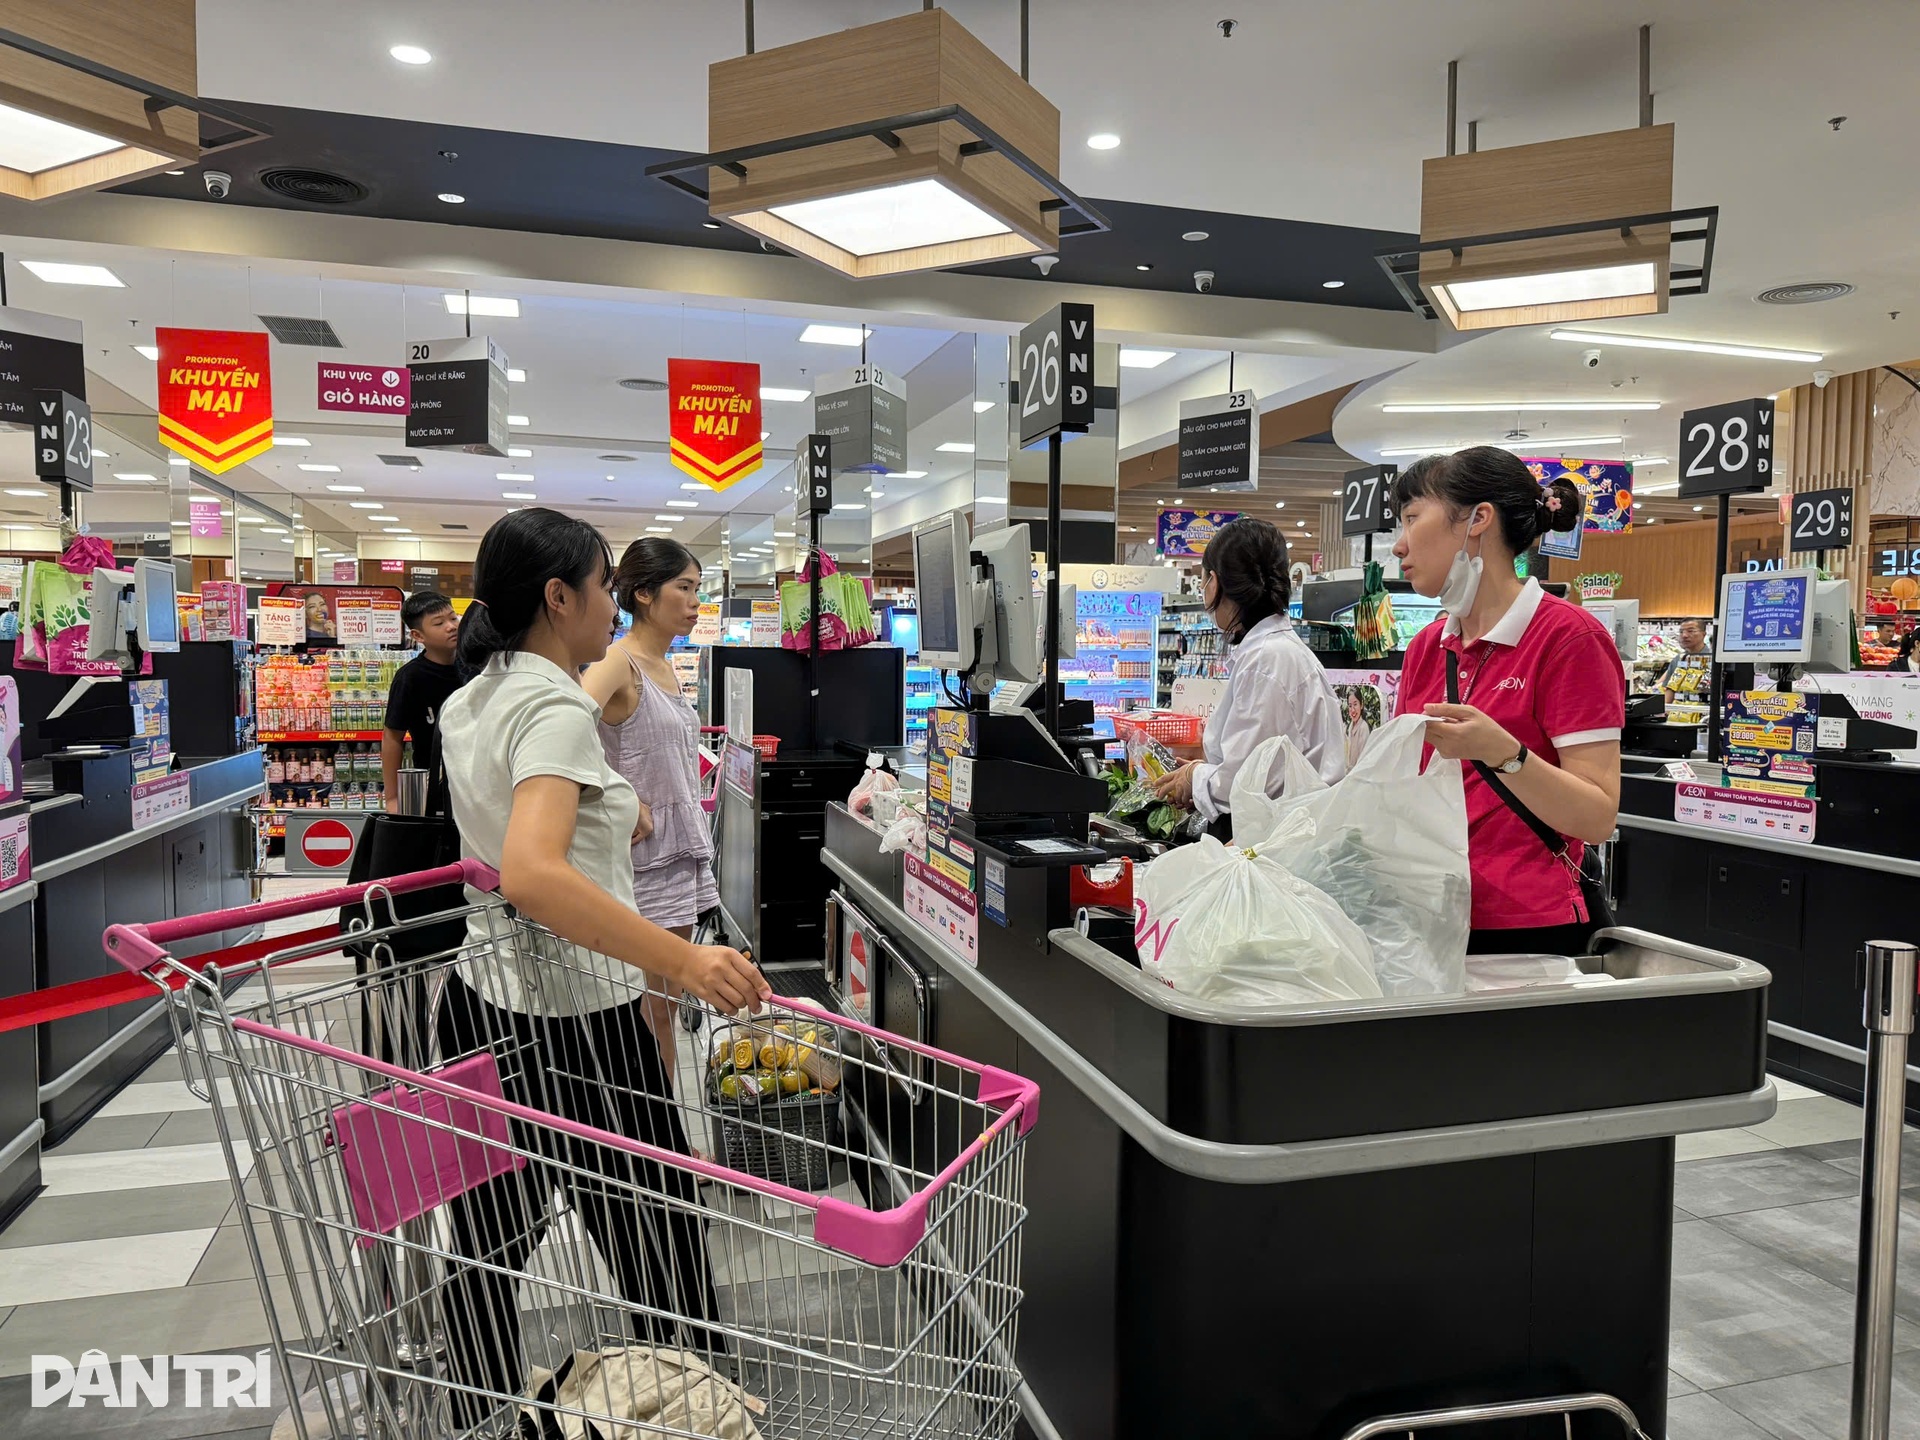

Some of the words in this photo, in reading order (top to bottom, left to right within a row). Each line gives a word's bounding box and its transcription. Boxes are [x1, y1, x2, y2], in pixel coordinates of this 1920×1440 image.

[185, 356, 238, 365] PROMOTION
[412, 345, 430, 359] 20
[1069, 320, 1088, 405] VNĐ
[169, 366, 260, 388] KHUYẾN
[323, 370, 346, 380] KHU
[349, 371, 372, 382] VỰC
[855, 368, 867, 384] 21
[874, 369, 882, 386] 22
[1023, 330, 1059, 418] 26
[323, 388, 354, 404] GIỎ
[359, 391, 405, 407] HÀNG
[691, 384, 734, 393] PROMOTION
[187, 390, 244, 418] MẠI
[678, 393, 752, 414] KHUYẾN
[1230, 394, 1245, 408] 23
[40, 401, 58, 463] VNĐ
[693, 415, 738, 440] MẠI
[65, 410, 91, 469] 23
[1686, 417, 1749, 478] 28
[1757, 410, 1770, 473] VNĐ
[796, 451, 810, 500] 25
[814, 445, 827, 498] VNĐ
[1345, 478, 1379, 522] 27
[1794, 500, 1835, 538] 29
[1840, 496, 1850, 537] VNĐ
[1583, 576, 1608, 588] Salad
[1584, 589, 1592, 597] TỰ
[1592, 588, 1612, 596] CHỌN
[358, 622, 367, 632] 01
[1862, 697, 1893, 708] MANG
[1860, 710, 1893, 720] TRƯỜNG
[1748, 795, 1767, 803] THÔNG
